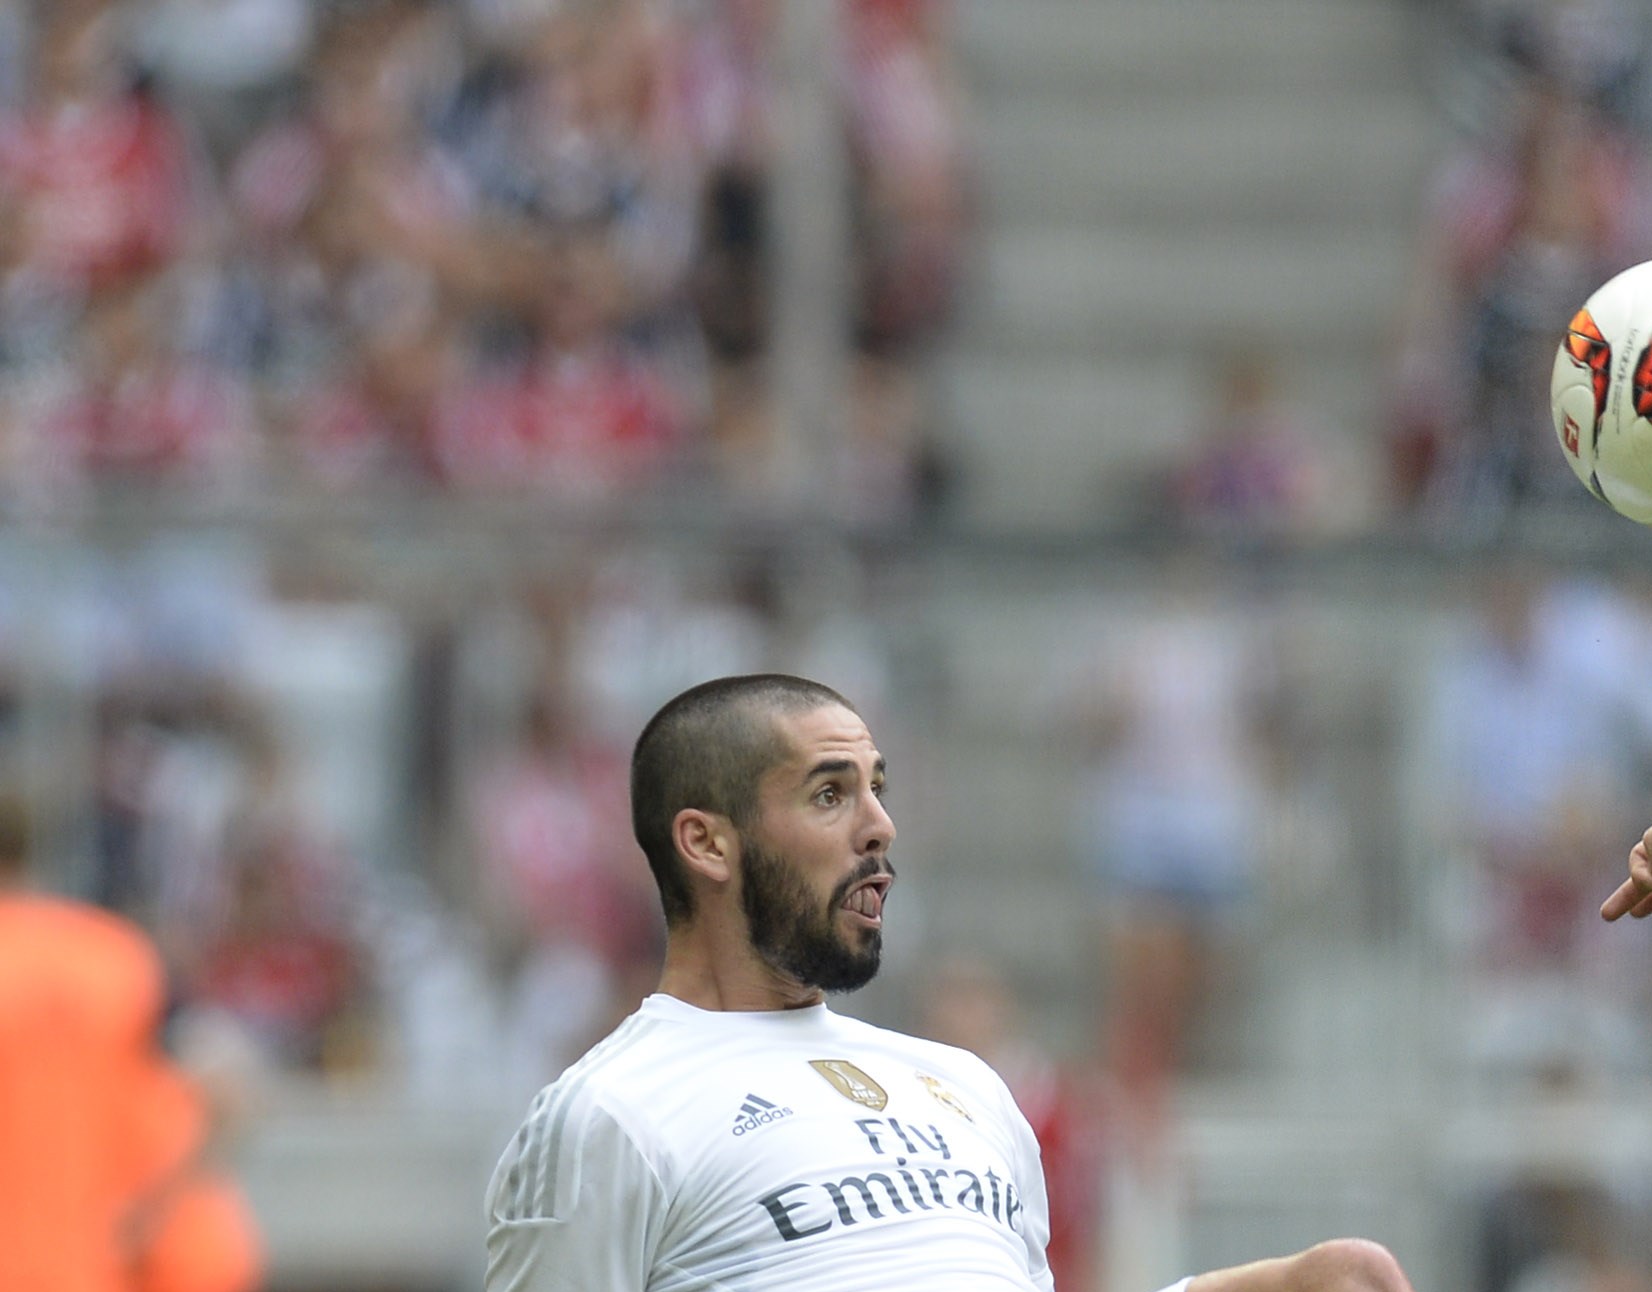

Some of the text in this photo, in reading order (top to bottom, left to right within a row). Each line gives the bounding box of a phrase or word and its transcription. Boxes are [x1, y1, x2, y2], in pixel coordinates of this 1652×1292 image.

[732, 1106, 794, 1137] adidas
[855, 1117, 951, 1160] Fly
[758, 1157, 1023, 1242] Emirate
